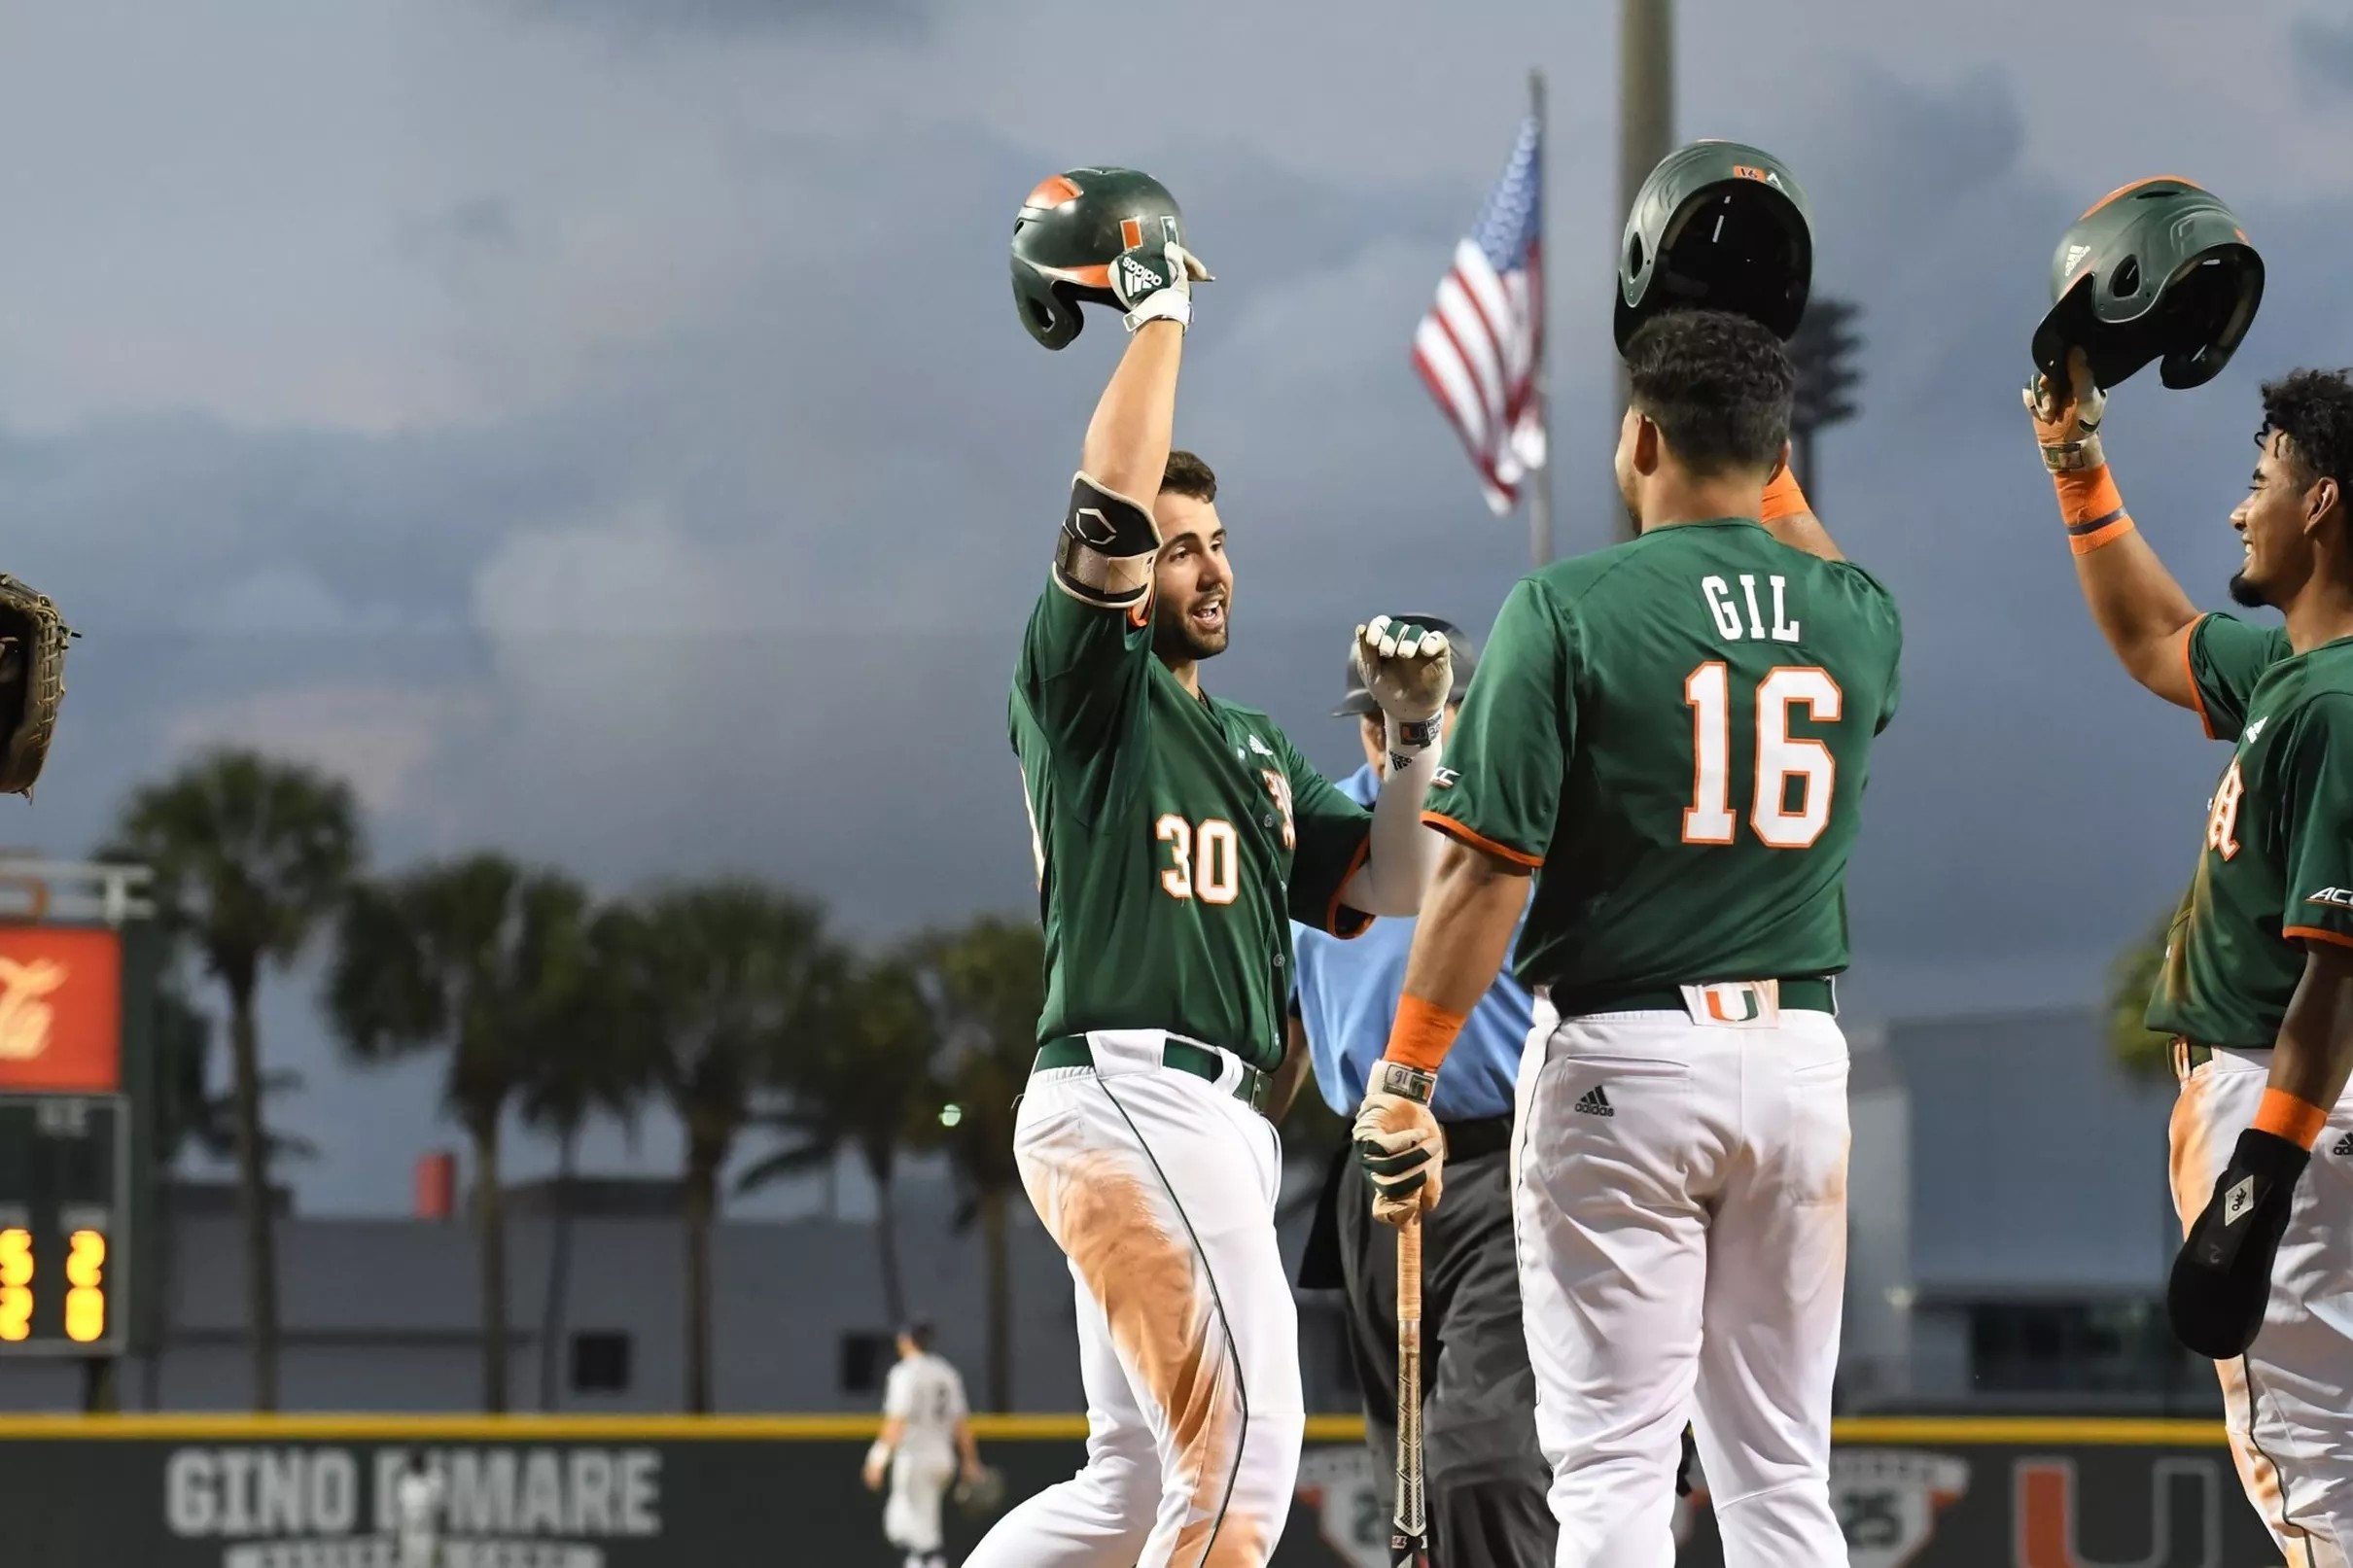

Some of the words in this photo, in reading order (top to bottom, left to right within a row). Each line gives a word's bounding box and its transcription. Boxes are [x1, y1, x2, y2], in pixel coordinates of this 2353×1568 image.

[1123, 256, 1163, 287] adidas
[1702, 575, 1799, 643] GIL
[1681, 661, 1843, 848] 16
[1155, 813, 1239, 905] 30
[2308, 886, 2353, 906] AC
[1705, 990, 1759, 1022] U
[1574, 1102, 1615, 1118] adidas
[165, 1447, 357, 1537] GINO
